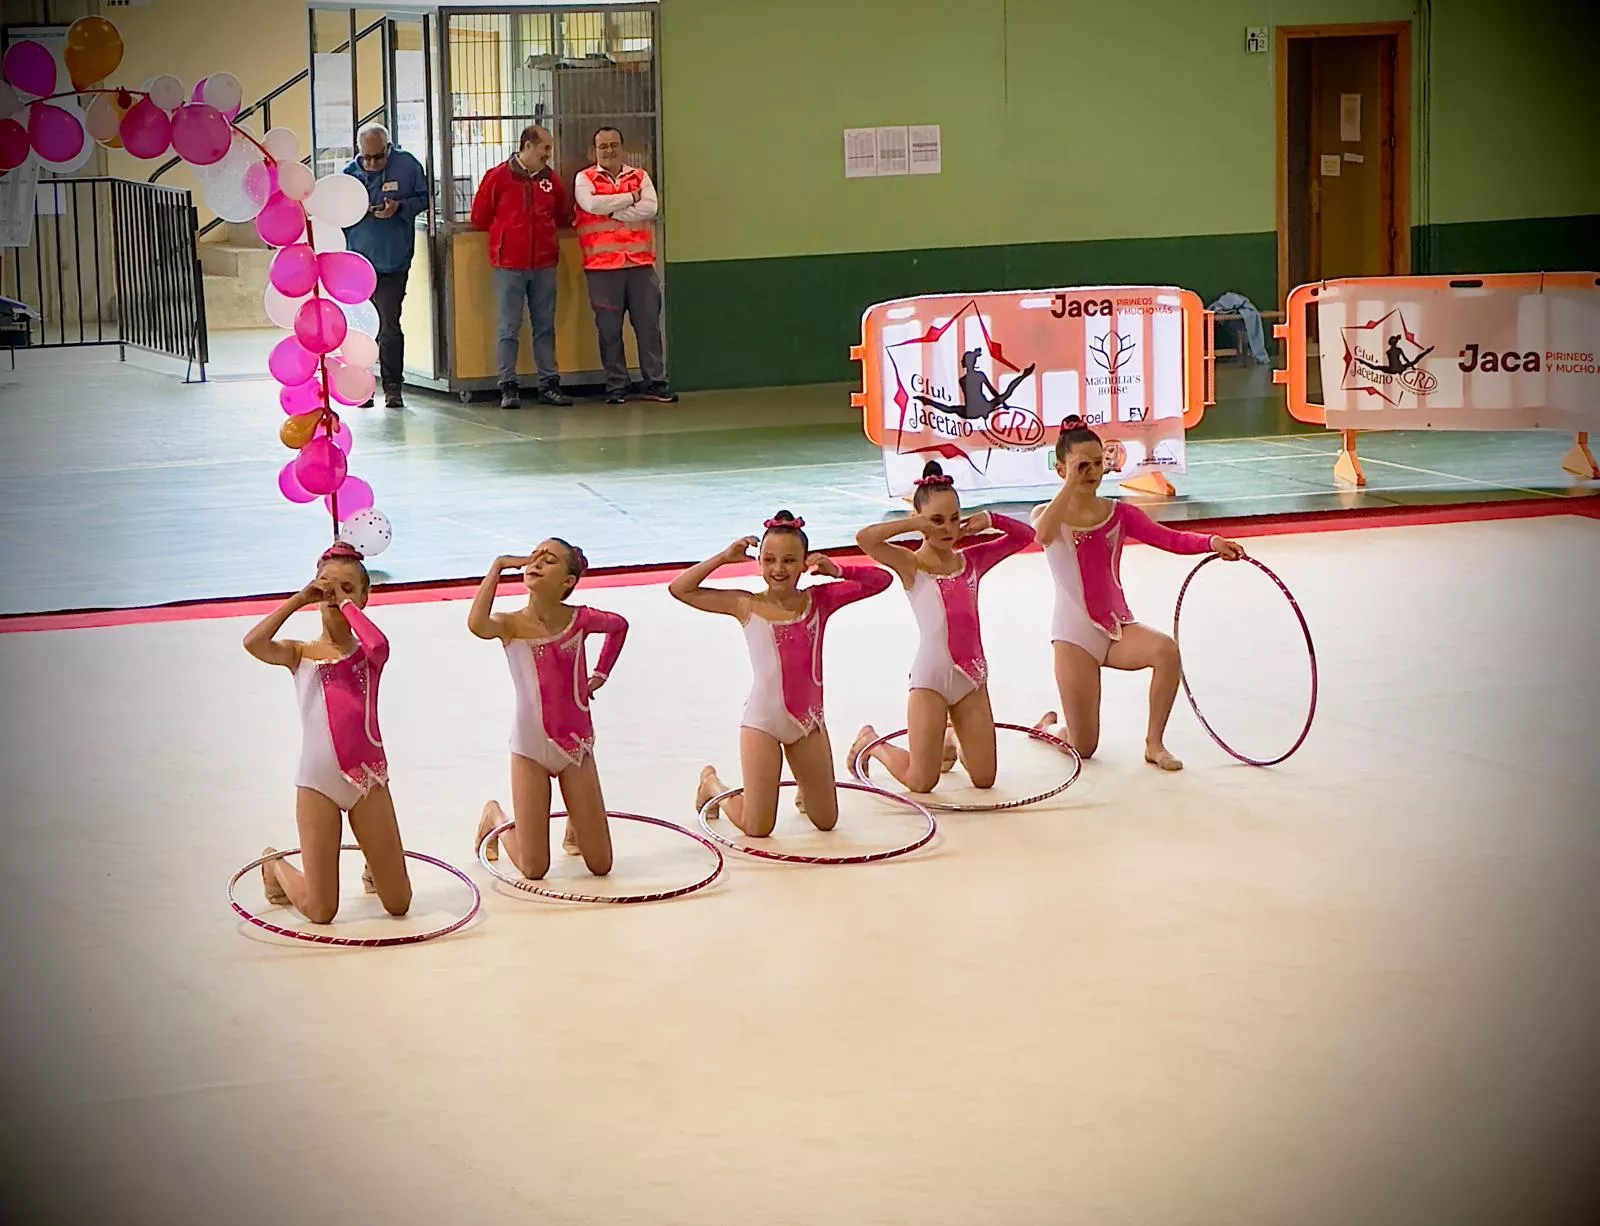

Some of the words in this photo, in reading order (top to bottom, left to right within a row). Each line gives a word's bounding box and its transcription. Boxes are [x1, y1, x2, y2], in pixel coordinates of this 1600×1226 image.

[1051, 294, 1113, 319] Jaca
[1117, 297, 1153, 306] PIRINEOS
[1124, 307, 1154, 316] MUCHO
[1458, 344, 1541, 373] Jaca
[1545, 351, 1594, 362] PIRINEOS
[1350, 361, 1393, 385] Jacetano
[1545, 363, 1552, 373] Y
[1556, 364, 1595, 374] MUCHO
[911, 373, 952, 402] Club
[1403, 371, 1435, 389] GRD
[909, 402, 973, 437] Jacetano
[990, 410, 1041, 441] GRD
[1081, 410, 1104, 424] roel
